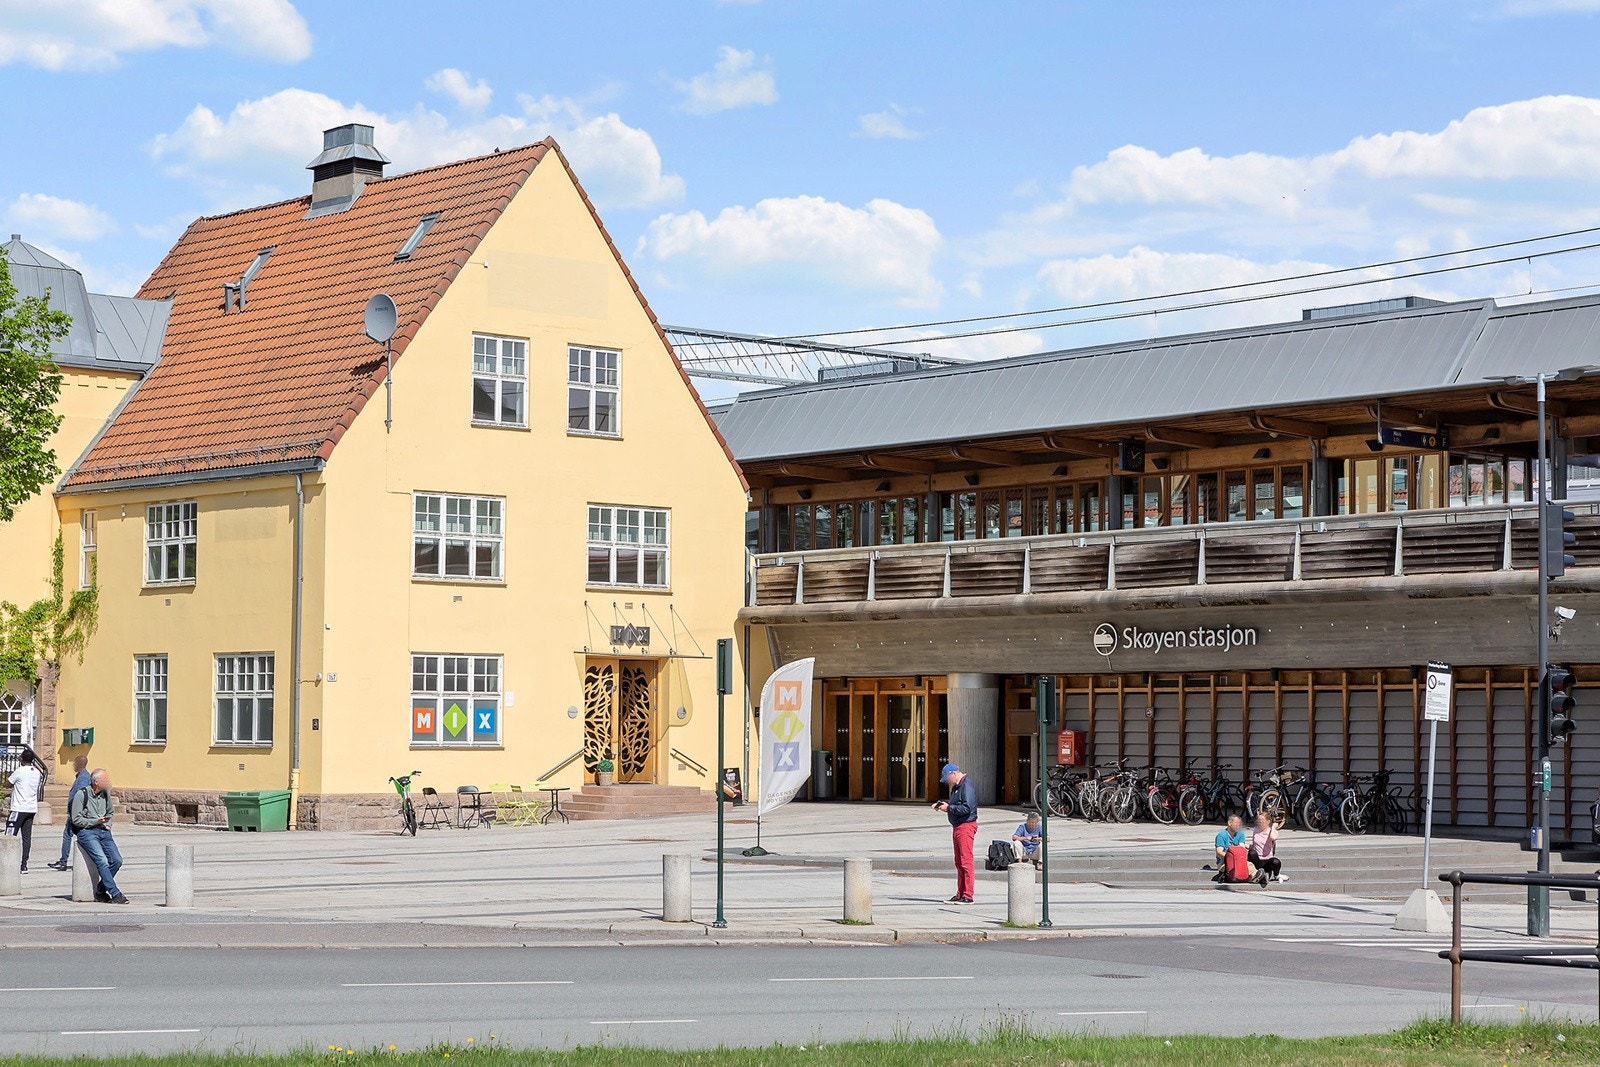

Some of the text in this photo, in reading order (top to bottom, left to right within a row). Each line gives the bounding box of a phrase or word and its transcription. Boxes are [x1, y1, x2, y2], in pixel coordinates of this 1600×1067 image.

[1122, 623, 1257, 655] Skøyen stasjon
[416, 712, 492, 729] MIX
[778, 685, 798, 767] MIX
